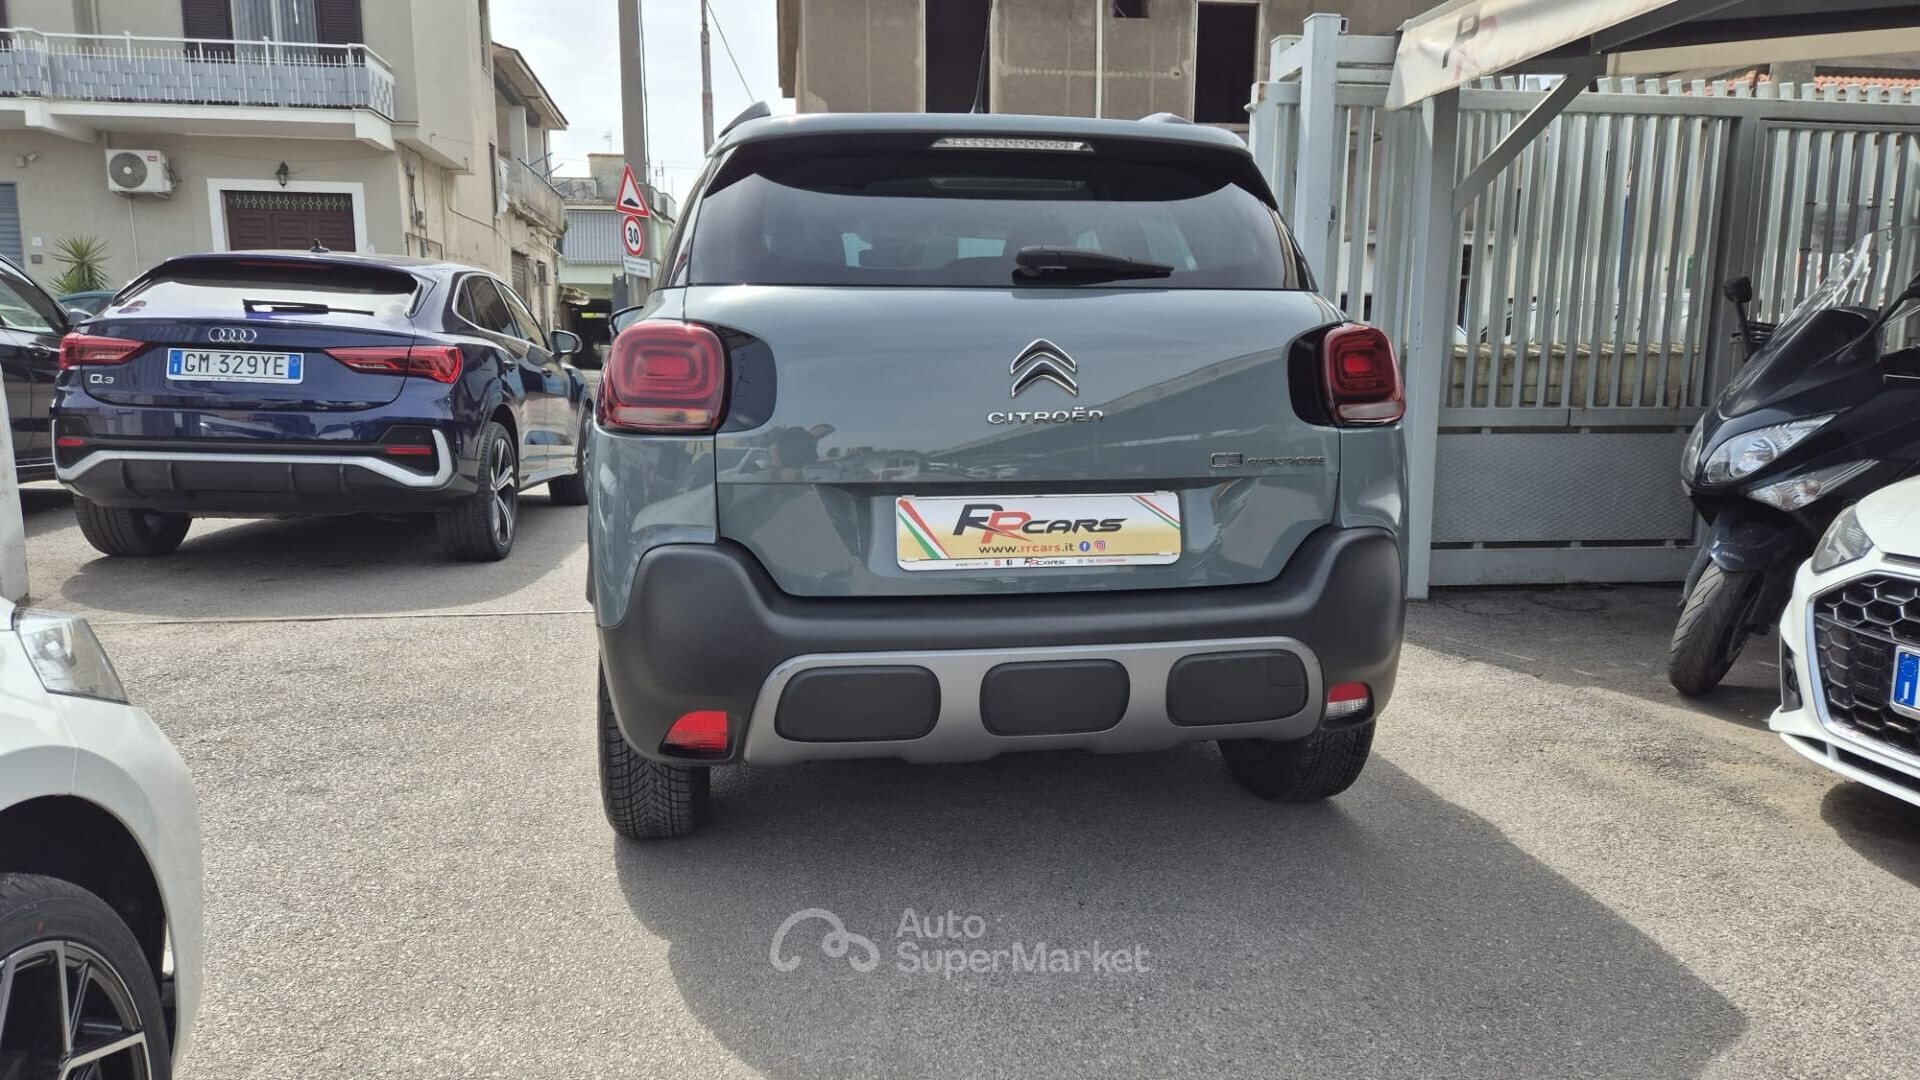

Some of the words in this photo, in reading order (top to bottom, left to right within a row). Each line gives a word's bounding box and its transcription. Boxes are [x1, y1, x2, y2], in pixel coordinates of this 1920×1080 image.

[628, 227, 639, 244] 30
[90, 374, 114, 384] Q3
[979, 542, 1075, 554] www.rrcars.it
